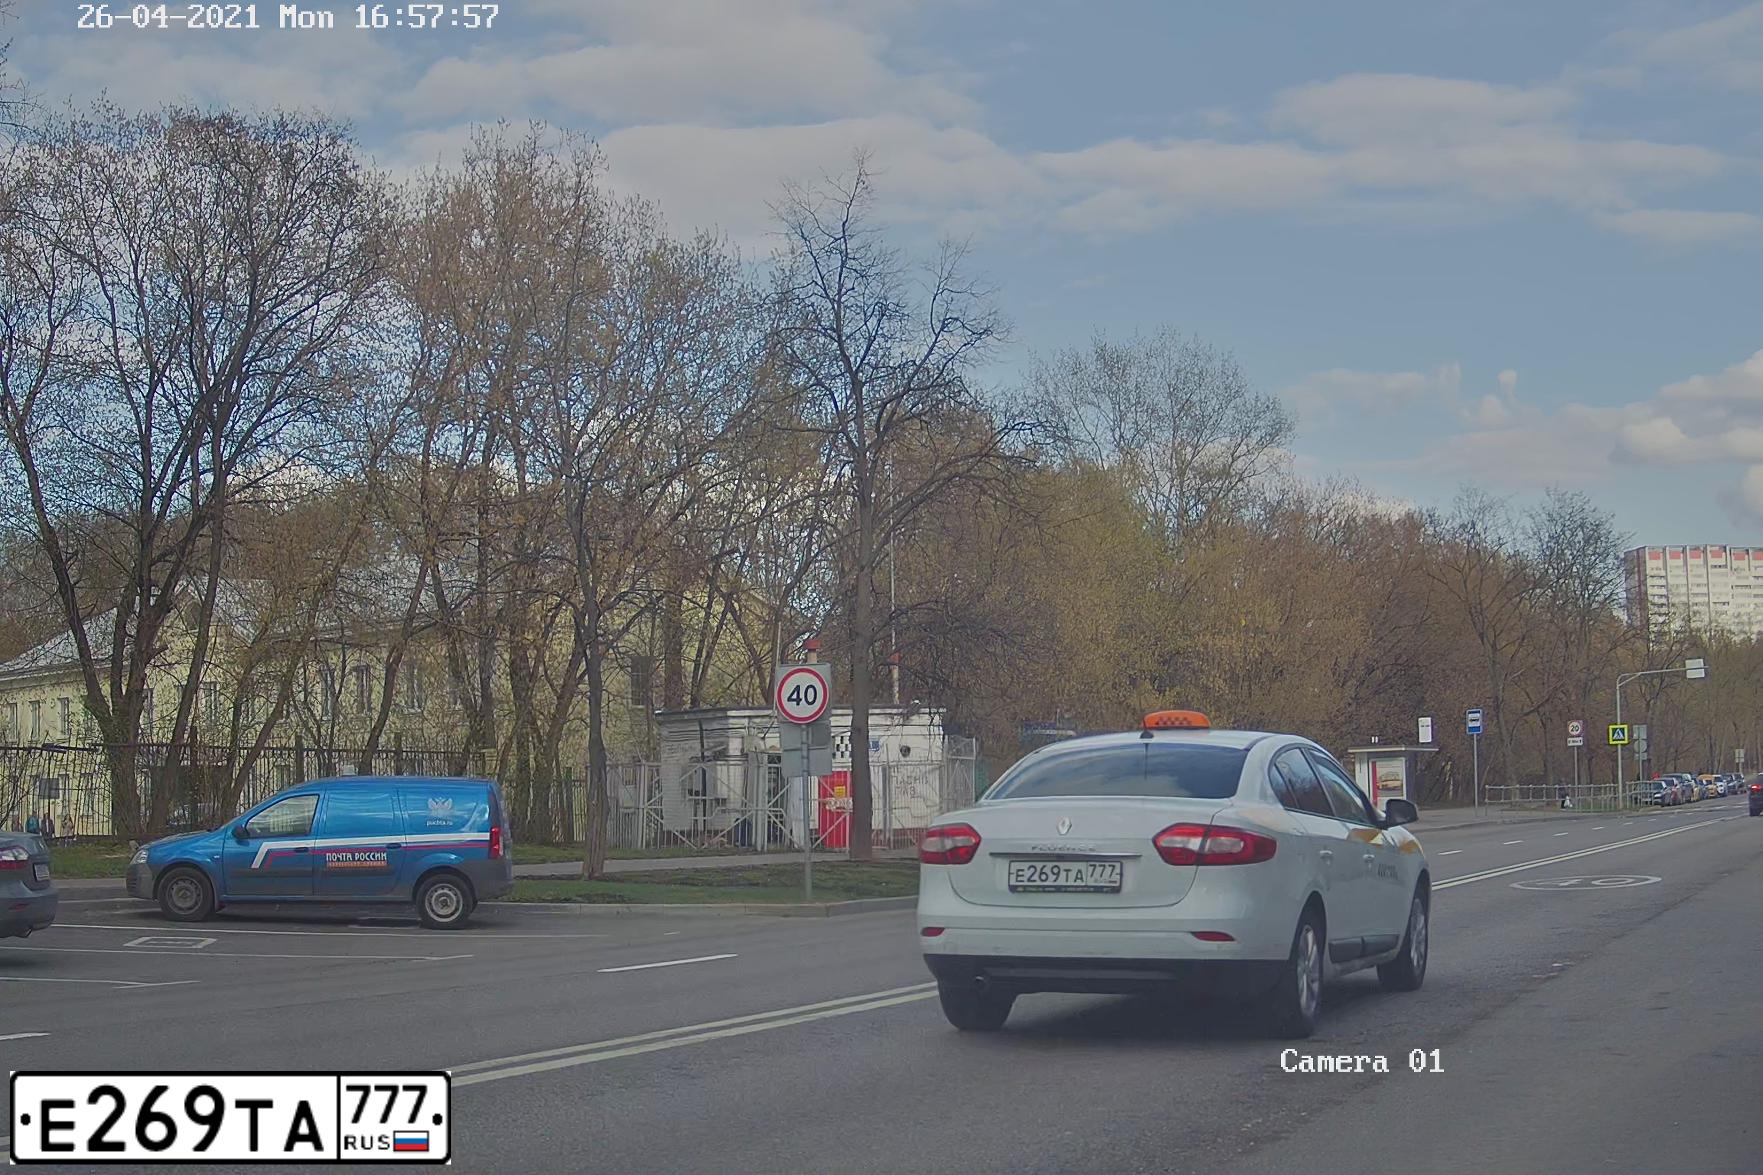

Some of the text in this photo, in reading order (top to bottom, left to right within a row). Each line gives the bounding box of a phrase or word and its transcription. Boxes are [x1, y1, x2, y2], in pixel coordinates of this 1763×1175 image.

[787, 684, 817, 706] 40
[426, 819, 453, 827] pochta.ru
[1031, 844, 1096, 852] FLUENCE
[326, 852, 387, 861] ПОЧТА РОССИИ
[1089, 863, 1117, 878] 777
